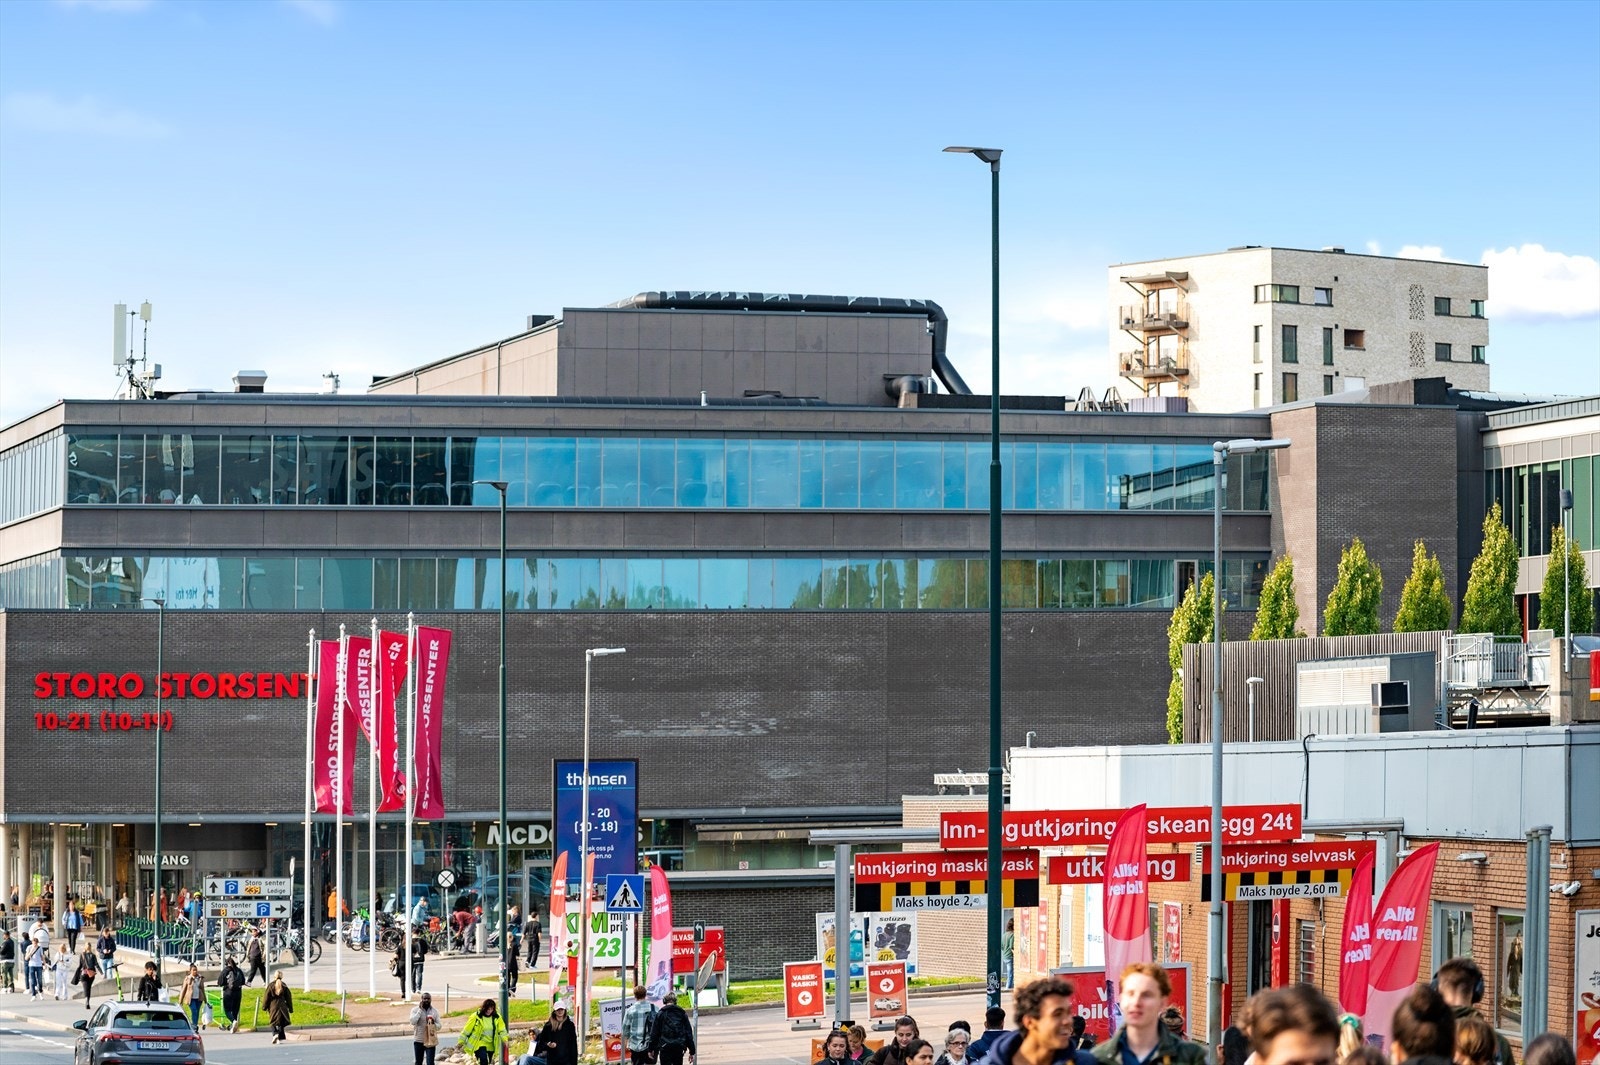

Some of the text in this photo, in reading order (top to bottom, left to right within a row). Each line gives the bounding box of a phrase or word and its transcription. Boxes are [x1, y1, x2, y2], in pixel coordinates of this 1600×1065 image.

[34, 672, 319, 698] STORO STORSENT
[35, 711, 173, 731] 10-21 (10-19)
[597, 808, 610, 818] 20
[601, 821, 618, 834] 18)
[943, 819, 985, 839] Inn-
[1260, 811, 1293, 833] 24t
[1220, 848, 1356, 868] nnkjøring selvvask
[857, 856, 1034, 878] Innkjøring maskivask
[267, 887, 286, 895] Ledige
[1239, 883, 1338, 899] Maks høyde 2,60 m
[895, 896, 924, 908] Maks
[927, 895, 960, 910] høyde
[791, 973, 818, 981] VASKE-
[870, 968, 903, 976] SELVVASK
[791, 980, 818, 988] MASKIN
